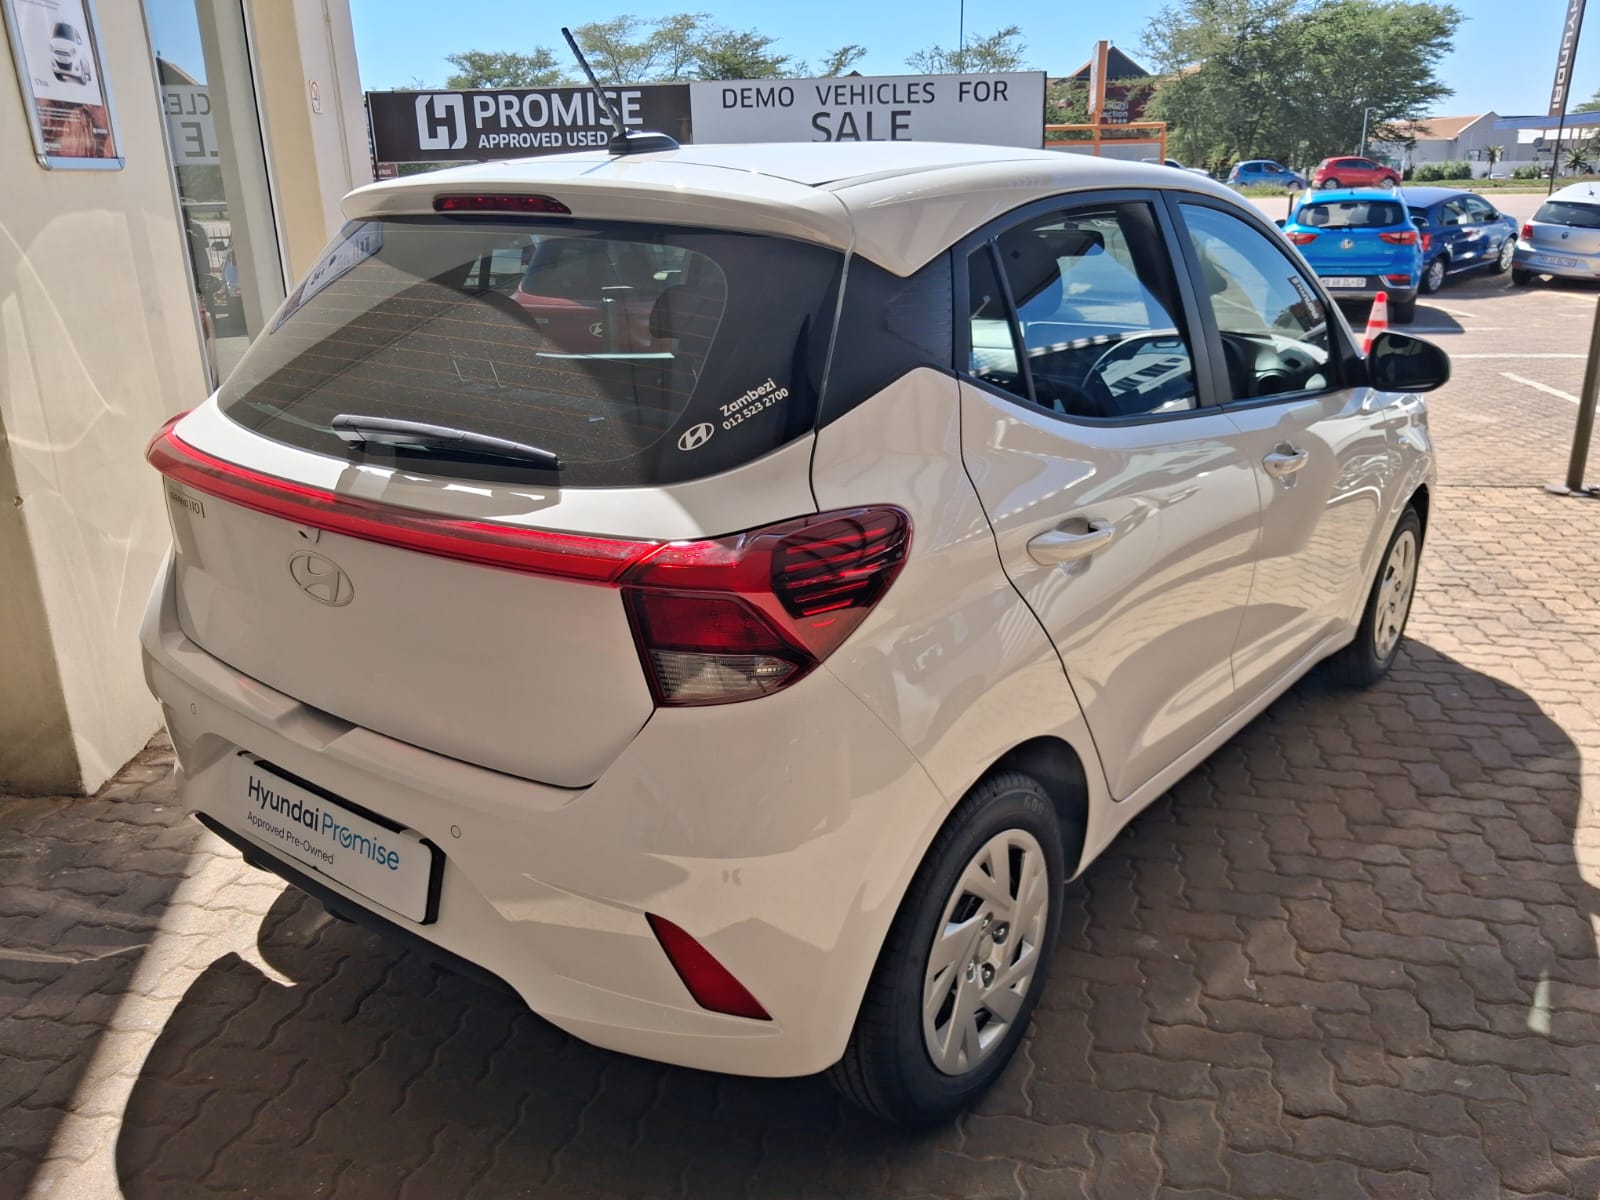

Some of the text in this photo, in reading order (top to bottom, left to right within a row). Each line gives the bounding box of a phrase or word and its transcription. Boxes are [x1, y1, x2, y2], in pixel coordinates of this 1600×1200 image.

[473, 90, 644, 129] PROMISE
[722, 80, 1008, 109] DEMO VEHICLES FOR
[478, 131, 608, 149] APPROVED USED
[811, 110, 912, 142] SALE
[720, 378, 777, 417] Zambezi
[722, 387, 789, 430] 012 523 2700
[248, 776, 319, 831] Hyundai
[248, 811, 334, 865] Approved Pre-Owned
